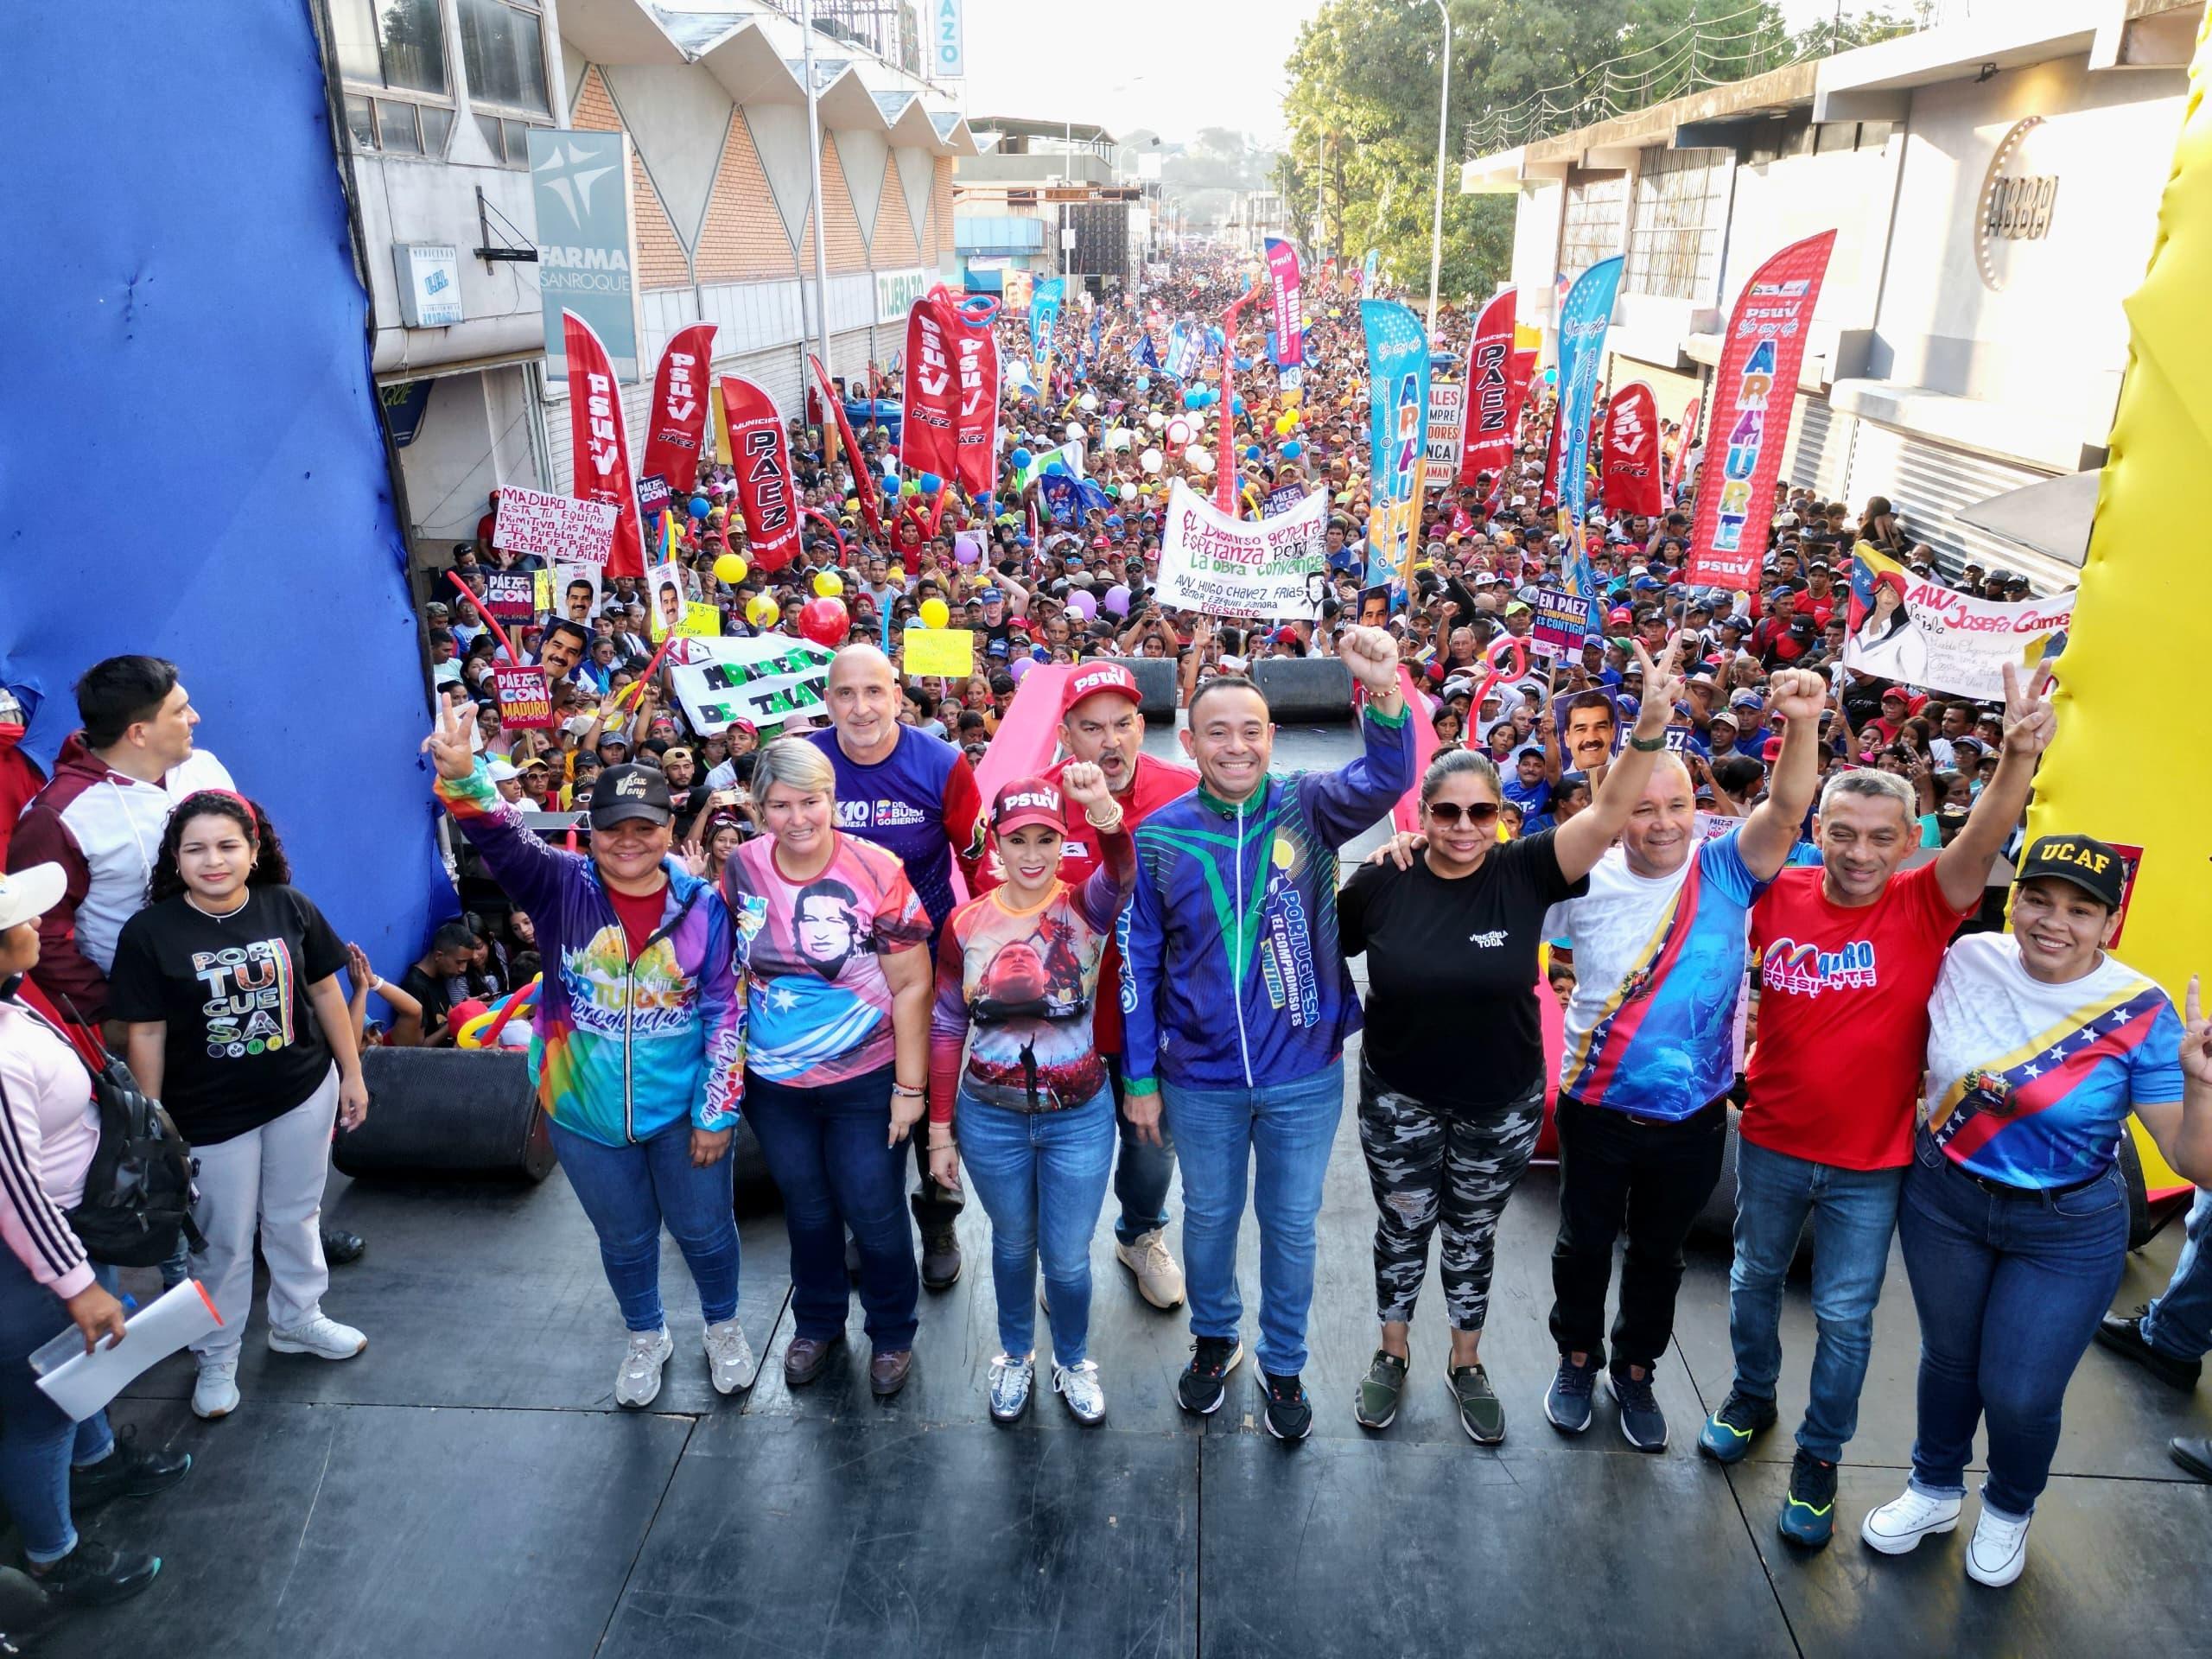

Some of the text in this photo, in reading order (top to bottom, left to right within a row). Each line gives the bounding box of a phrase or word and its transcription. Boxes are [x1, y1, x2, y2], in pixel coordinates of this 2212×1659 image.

[1986, 175, 2059, 240] ABBA
[538, 245, 630, 271] FARMA
[540, 270, 631, 292] SANROQUE
[880, 274, 925, 318] TIJERAZO
[1736, 318, 1799, 339] Yo soy de
[1476, 344, 1507, 432] PÁEZ
[1712, 339, 1777, 552] ARAURE
[747, 429, 788, 532] PÁEZ
[502, 487, 567, 511] MADURO
[640, 490, 669, 502] CON
[538, 507, 553, 518] TU
[1268, 518, 1322, 547] genera
[556, 545, 571, 557] EL
[488, 590, 533, 603] CON
[1198, 580, 1224, 595] HUGO
[1539, 593, 1588, 616] EN PÁEZ
[1536, 616, 1585, 636] ES CONTIGO
[1543, 609, 1586, 626] COMPROMISO
[499, 689, 545, 702] CON
[502, 702, 550, 718] MADURO
[697, 702, 737, 723] DE
[877, 816, 925, 826] GOBIERNO
[892, 808, 924, 818] BUEN
[2041, 843, 2111, 875] UCAF
[1477, 938, 1504, 949] TODA
[192, 941, 276, 972] POR
[1280, 889, 1321, 1029] PORTUGUESA
[195, 957, 276, 999] TU
[1274, 931, 1300, 1014] COMPROMISO
[1291, 1012, 1302, 1028] ES
[202, 987, 281, 1017] GUE
[207, 1009, 283, 1044] SA
